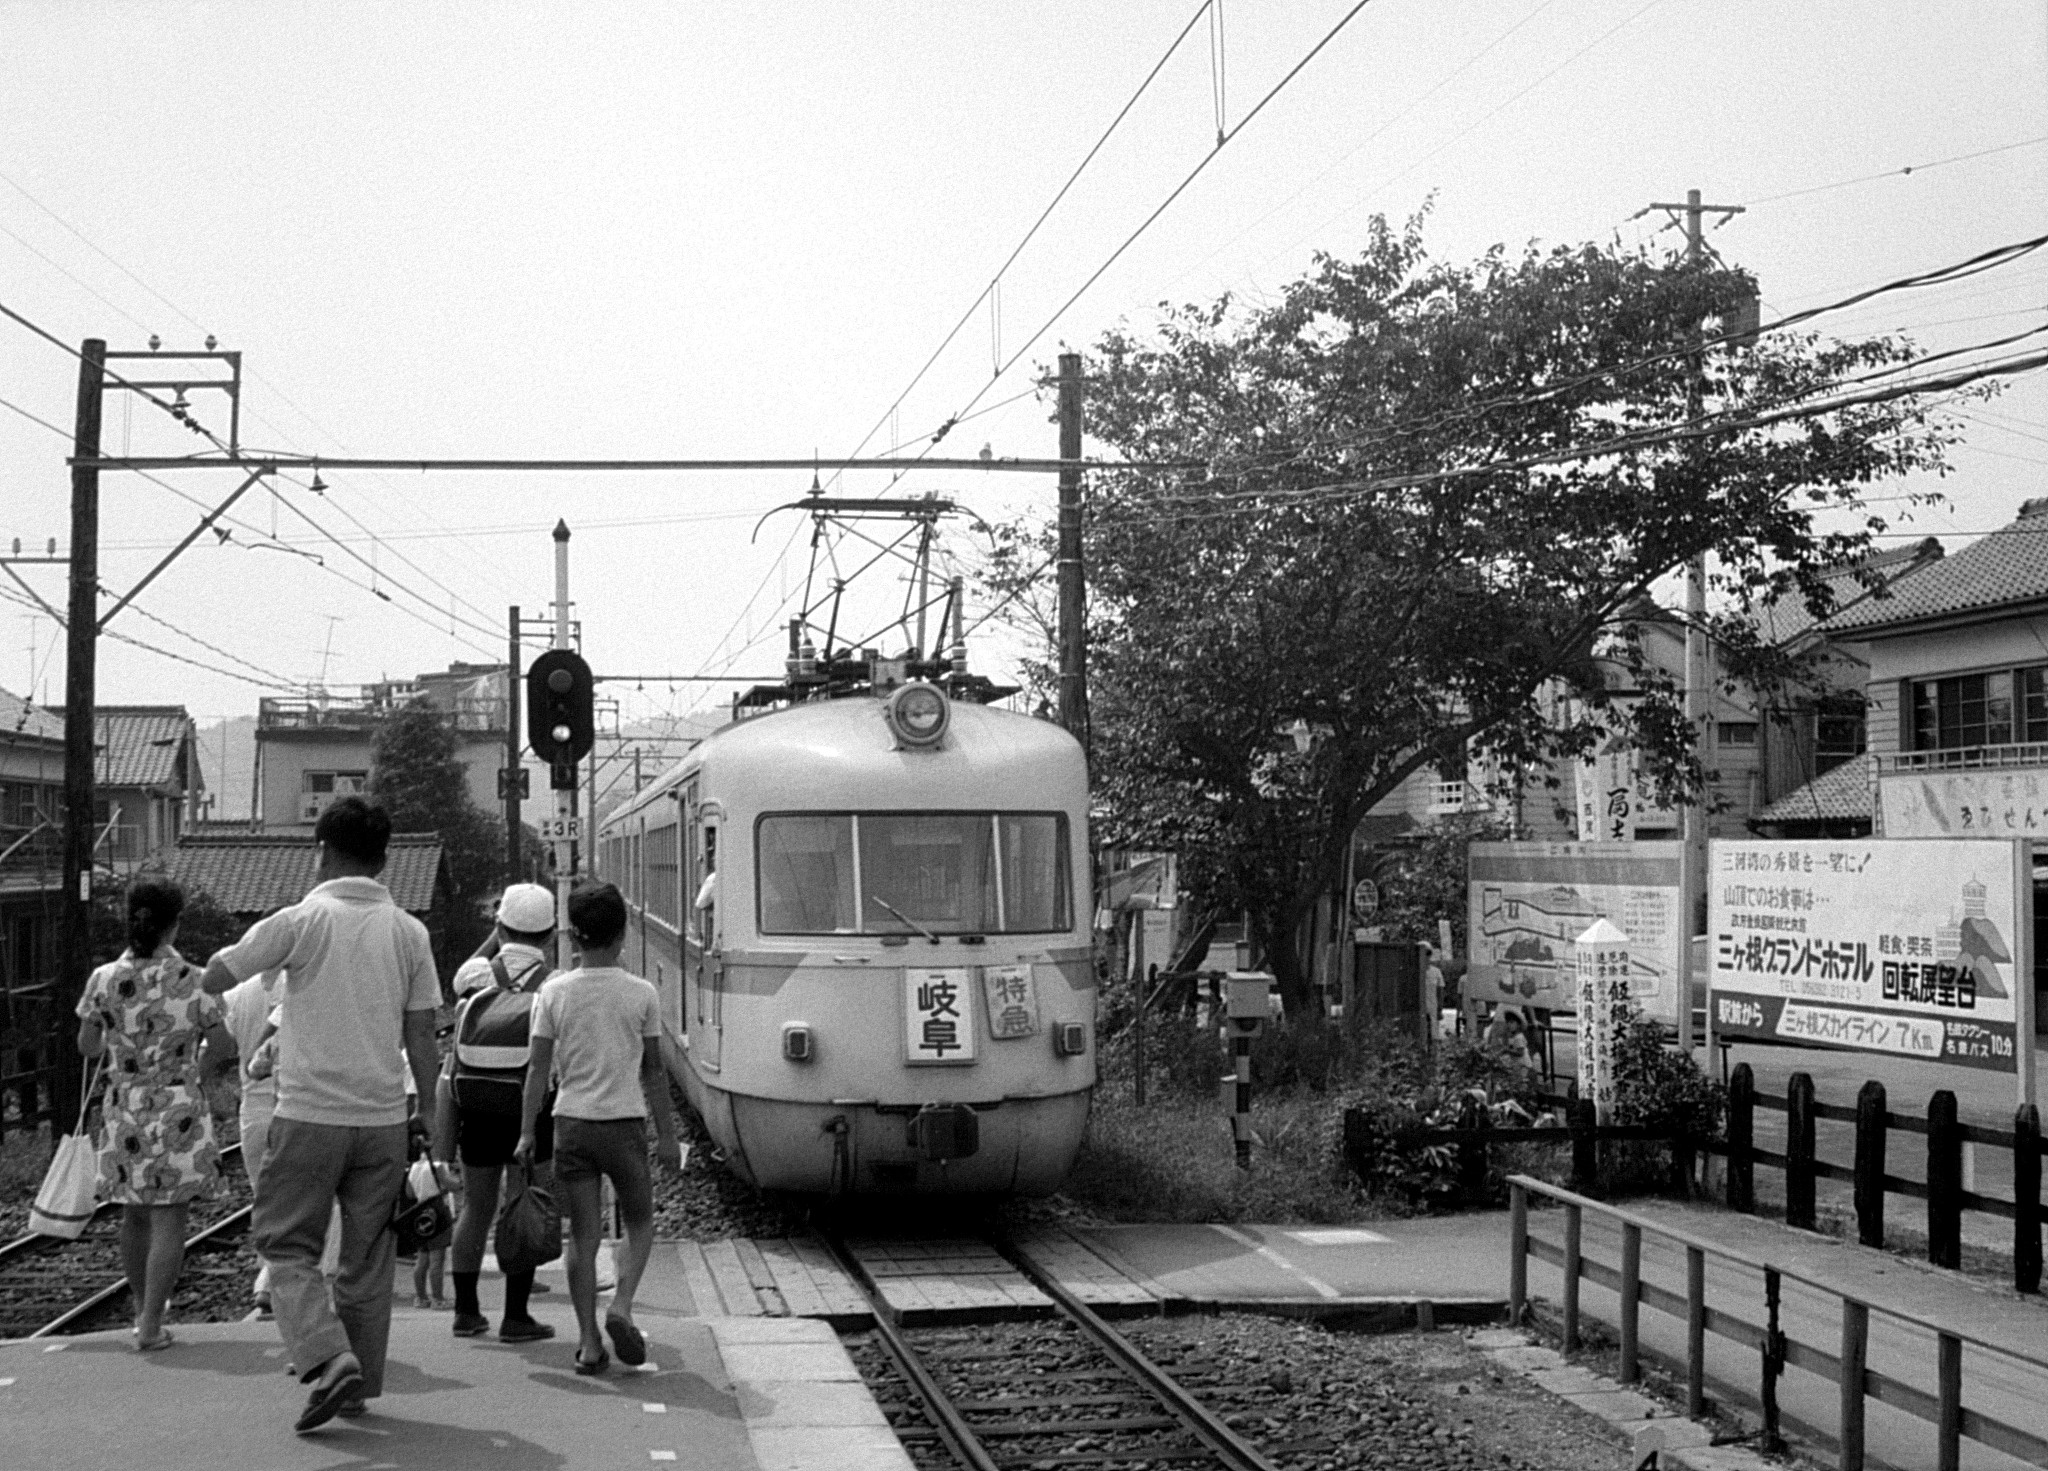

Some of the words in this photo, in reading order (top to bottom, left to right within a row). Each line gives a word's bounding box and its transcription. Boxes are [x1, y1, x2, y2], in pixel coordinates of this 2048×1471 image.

[1717, 933, 1875, 983] 三ヶ根グランドホテル
[996, 976, 1033, 1036] 特急
[1882, 960, 1977, 1009] 回転展望台
[918, 980, 961, 1057] 岐阜
[1718, 998, 1764, 1027] 駅前から
[1785, 1009, 1890, 1044] 三ヶ根スカイライン
[1991, 1034, 2013, 1058] 10分
